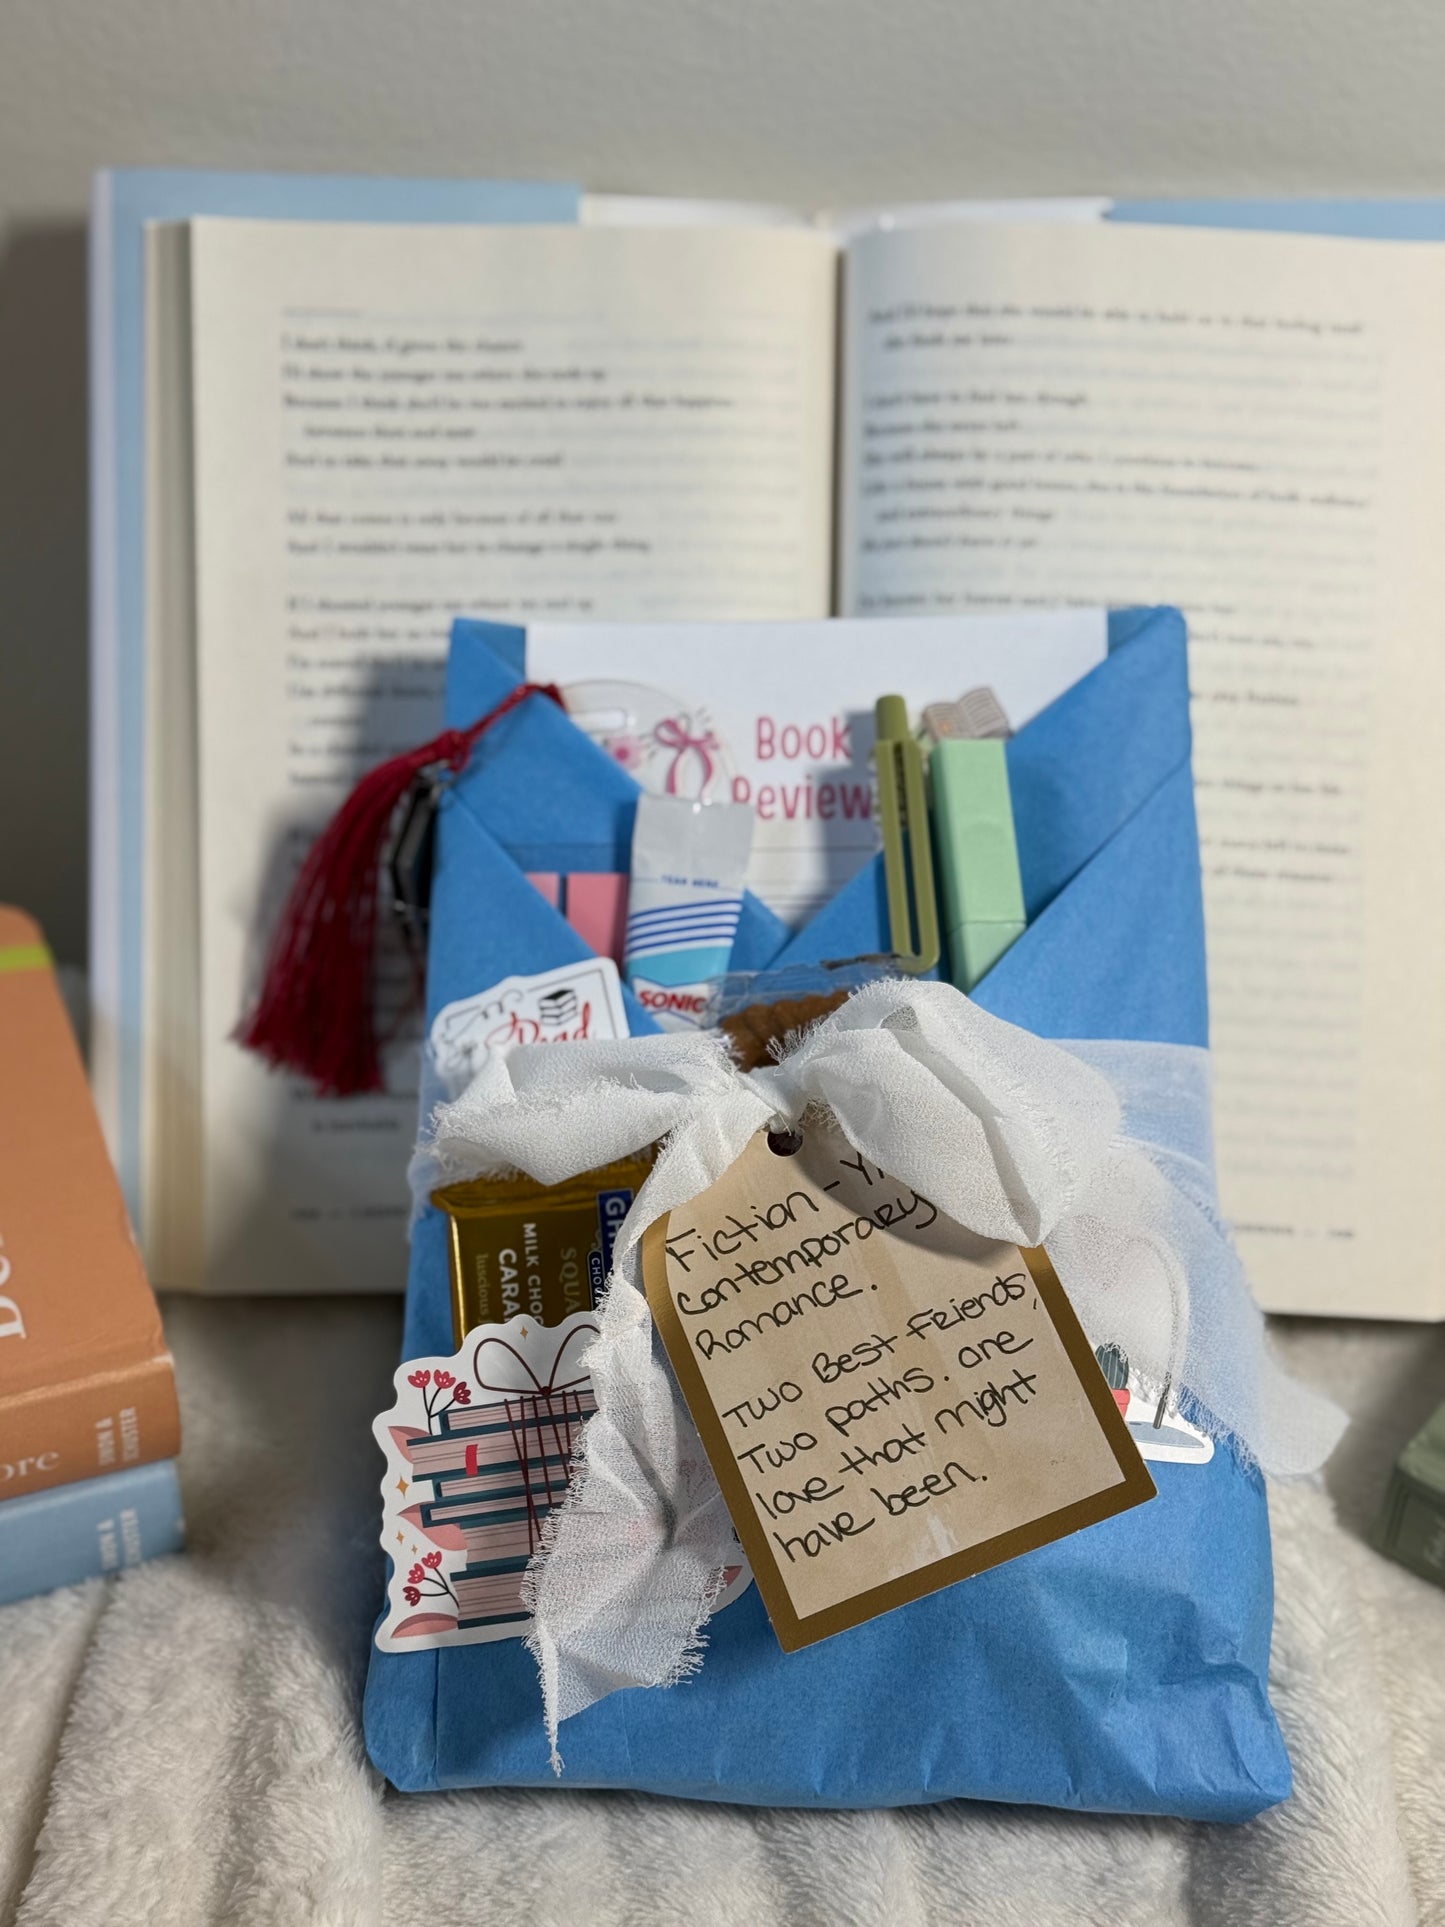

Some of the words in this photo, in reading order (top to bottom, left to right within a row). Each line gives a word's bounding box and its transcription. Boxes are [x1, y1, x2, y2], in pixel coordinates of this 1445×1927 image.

[757, 716, 852, 761] Book
[731, 775, 872, 820] Review
[638, 989, 708, 1013] SONIC
[522, 1222, 540, 1267] MILK
[665, 1191, 819, 1272] Fiction
[498, 1248, 521, 1323] CARA
[695, 1274, 878, 1360] Romance.
[812, 1334, 898, 1383] Best
[737, 1432, 818, 1474] Two
[825, 1367, 951, 1437] paths.
[755, 1477, 845, 1519] love
[839, 1423, 926, 1475] that
[934, 1368, 1037, 1434] might
[773, 1512, 876, 1562] have
[870, 1462, 988, 1516] been.
